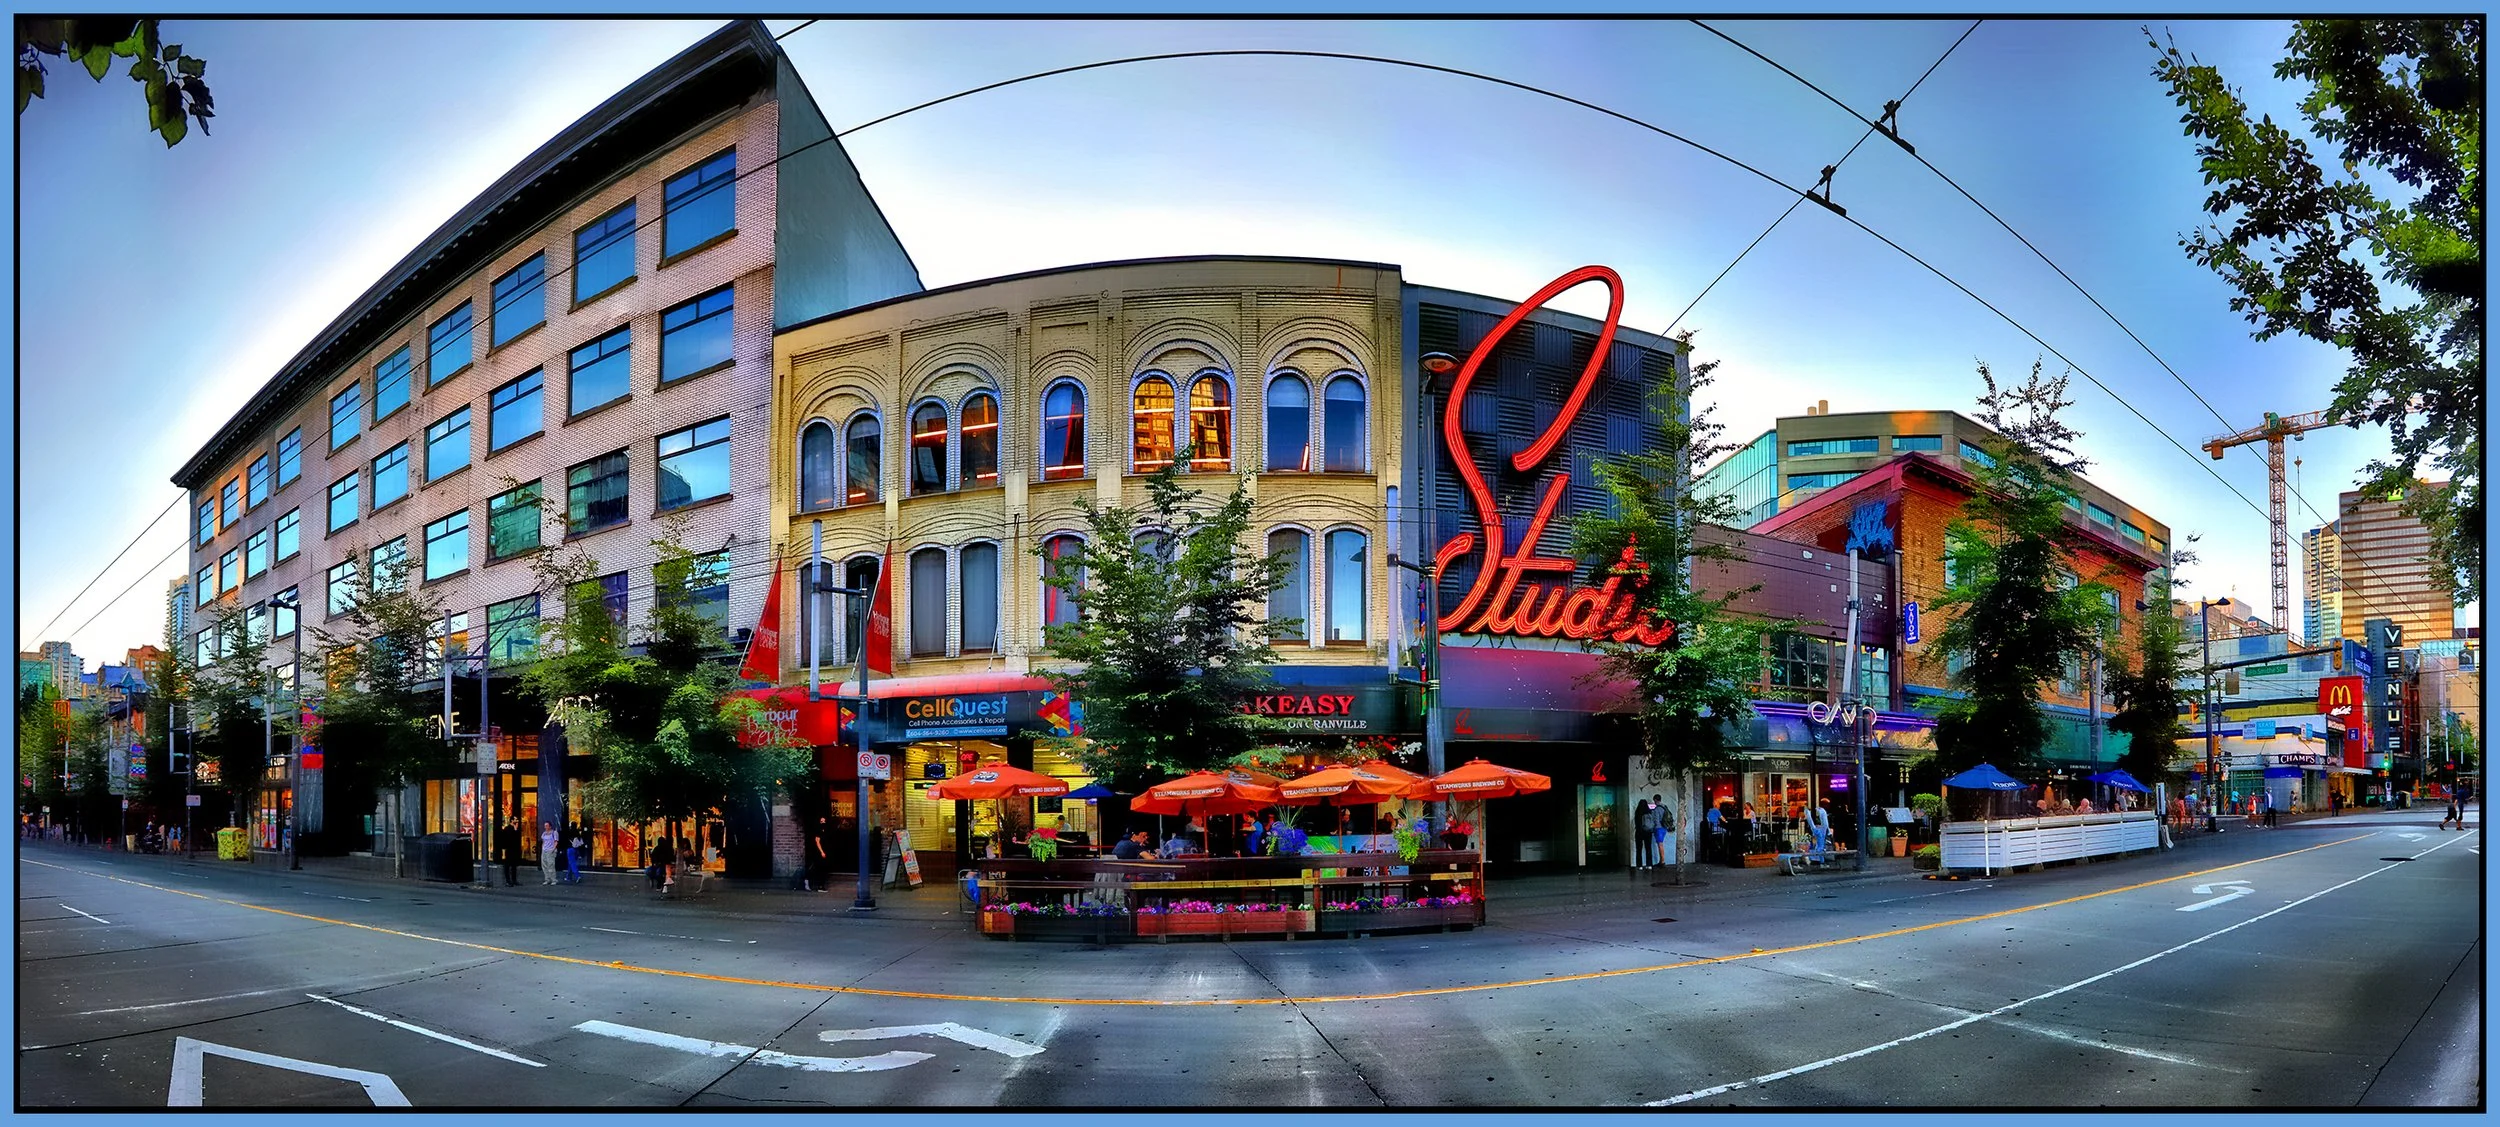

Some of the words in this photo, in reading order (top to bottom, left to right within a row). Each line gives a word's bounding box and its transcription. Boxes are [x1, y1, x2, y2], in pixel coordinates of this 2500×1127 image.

[1437, 265, 1675, 646] Studio
[2384, 627, 2402, 749] VENUE
[905, 696, 1008, 719] CellQuest
[941, 718, 977, 726] Accessories
[984, 716, 1006, 724] Repair
[2280, 755, 2315, 763] CHAMPS
[2110, 780, 2133, 788] PERONI
